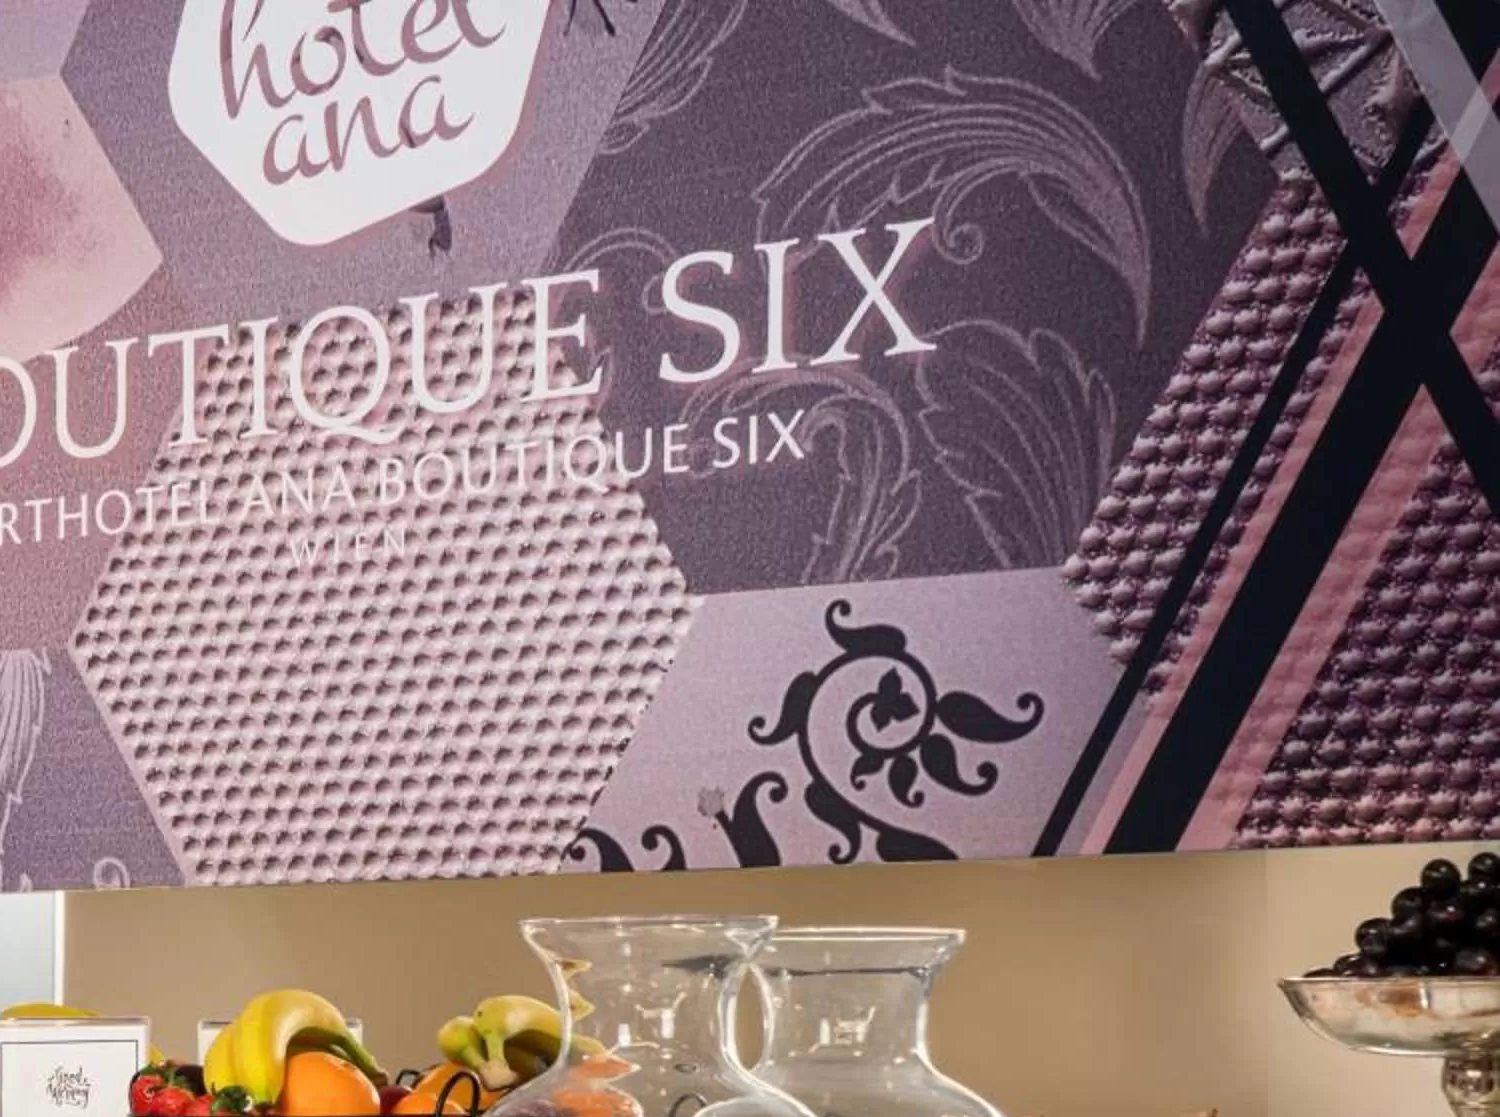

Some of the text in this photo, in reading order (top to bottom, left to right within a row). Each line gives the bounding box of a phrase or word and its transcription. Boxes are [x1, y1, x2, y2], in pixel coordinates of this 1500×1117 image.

[263, 75, 475, 185] ana
[658, 217, 937, 384] SIX
[241, 466, 357, 518] ANA
[379, 424, 689, 505] BOUTIQUE
[712, 409, 805, 469] SIX
[290, 528, 405, 567] WIEN
